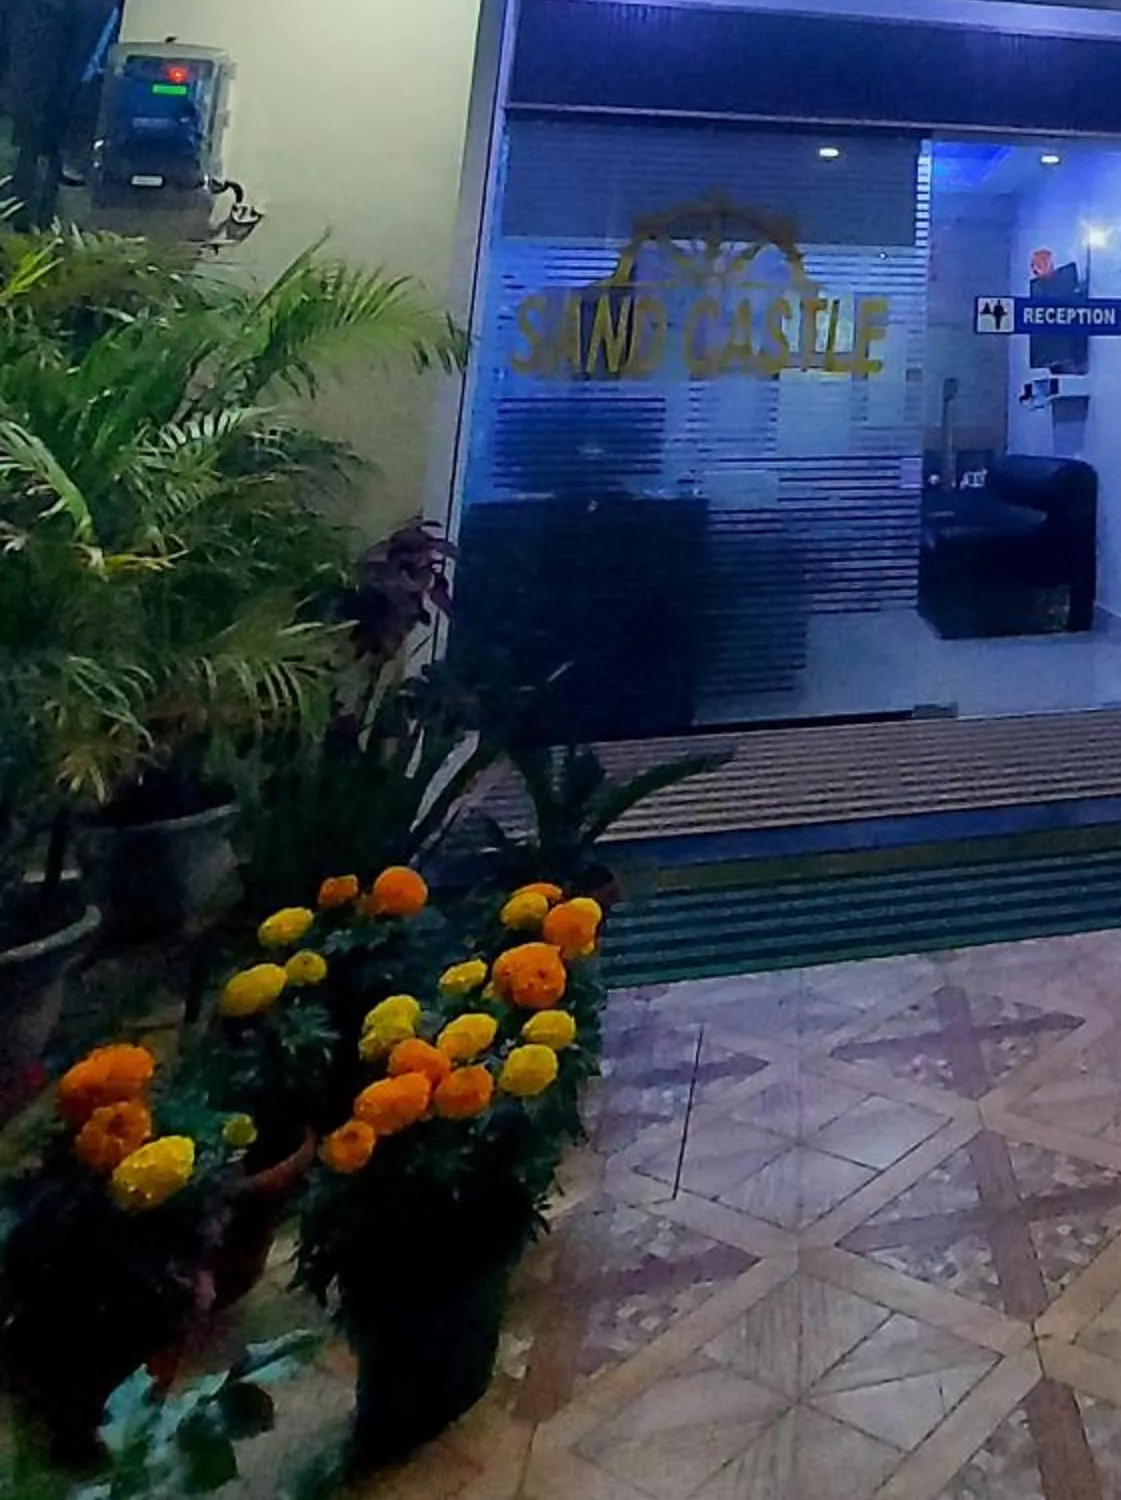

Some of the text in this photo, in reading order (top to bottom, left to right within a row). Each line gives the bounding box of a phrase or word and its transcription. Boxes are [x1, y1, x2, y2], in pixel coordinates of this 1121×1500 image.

[511, 293, 888, 376] SAND CASTLE
[1023, 307, 1116, 325] RECEPTION
